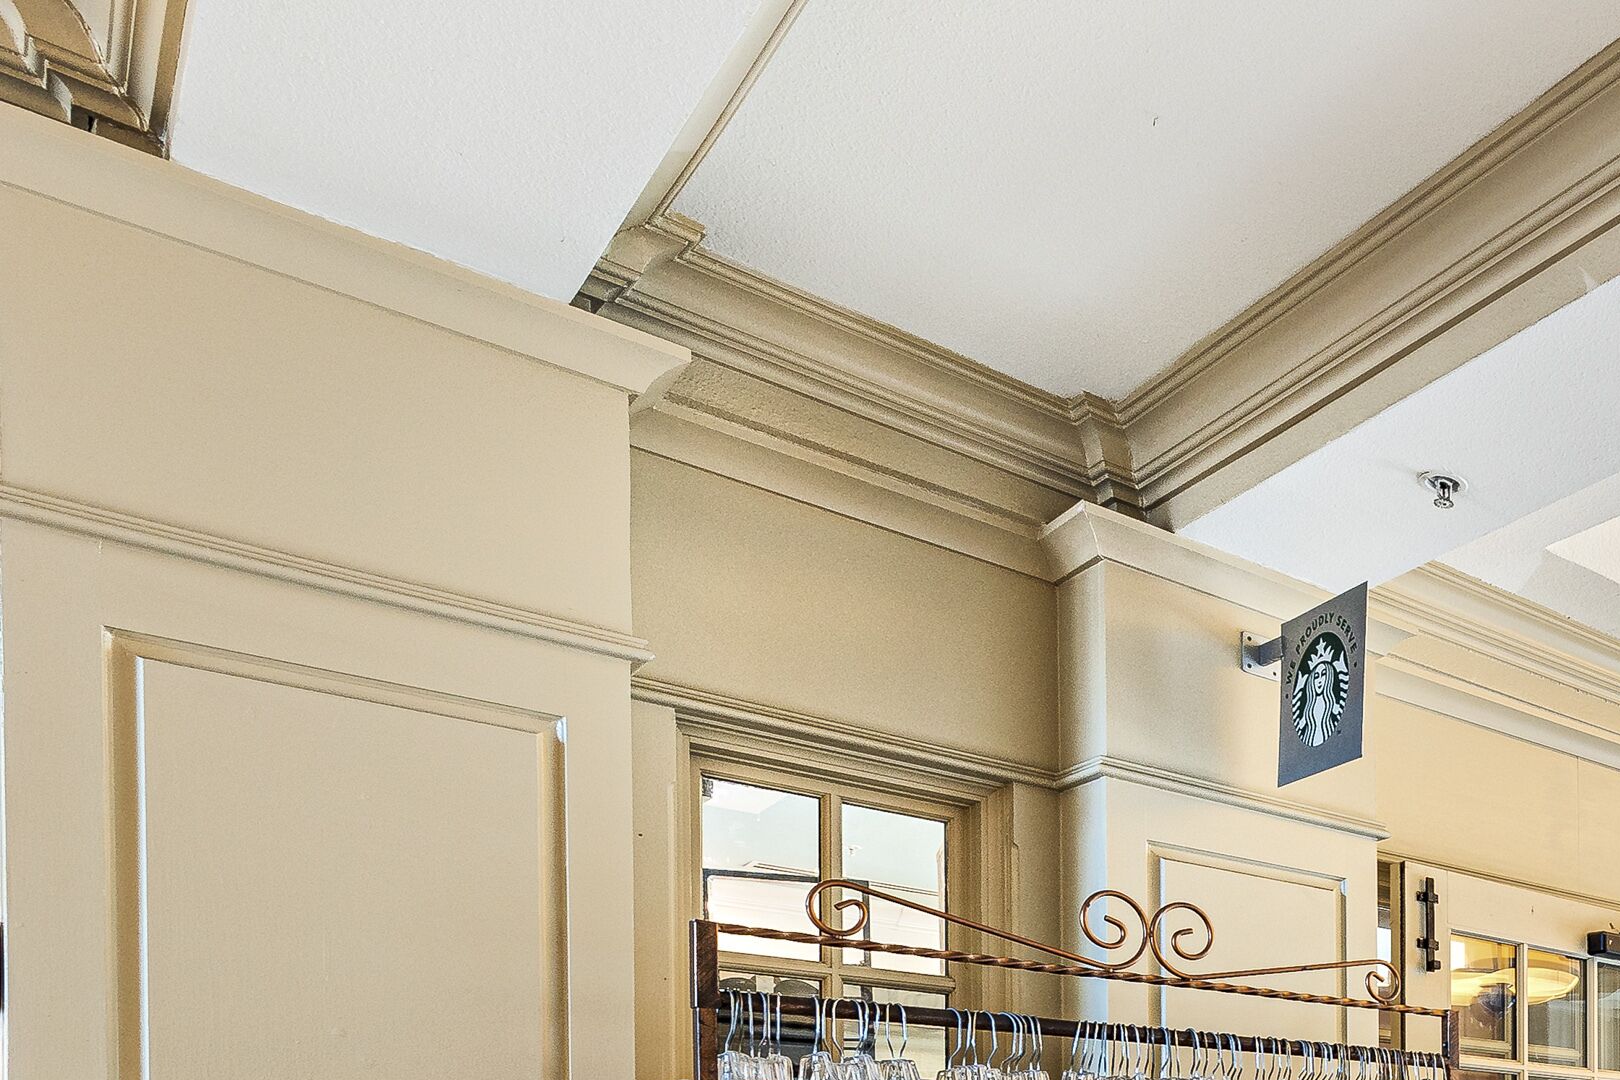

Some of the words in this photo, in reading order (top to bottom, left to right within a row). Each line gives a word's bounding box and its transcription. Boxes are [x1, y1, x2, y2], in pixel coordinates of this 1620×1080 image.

[1286, 660, 1297, 684] WE
[1295, 612, 1335, 655] PROUDLY
[1336, 615, 1358, 654] SERVE
